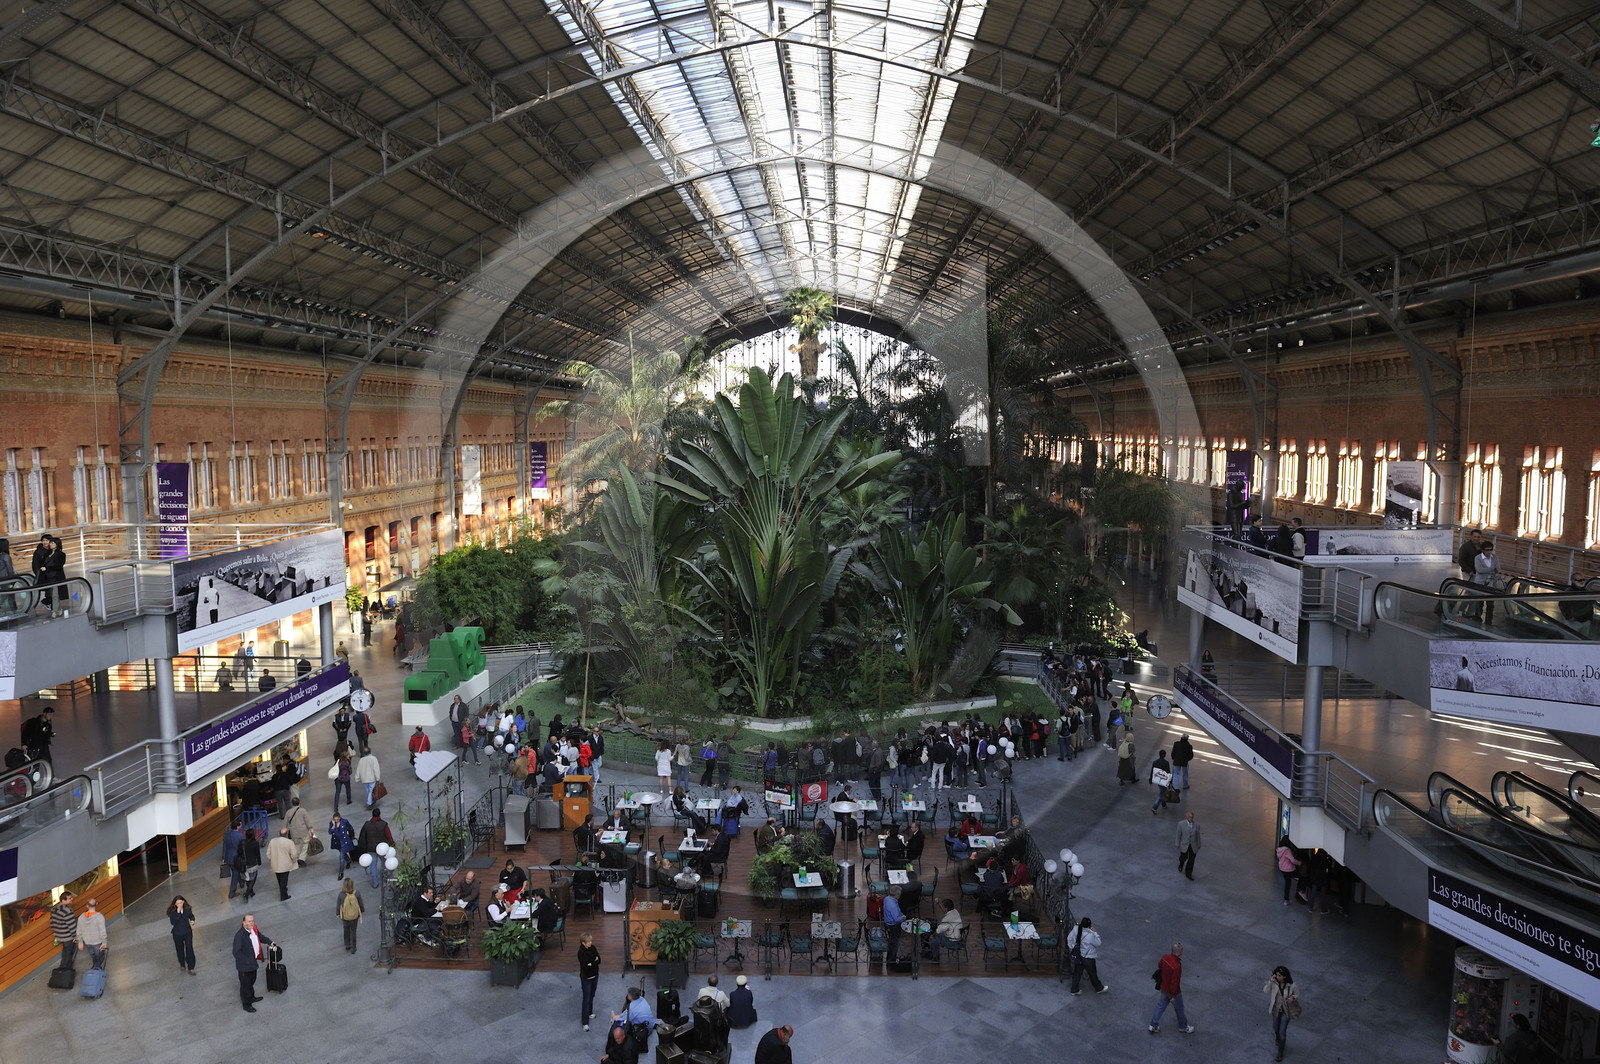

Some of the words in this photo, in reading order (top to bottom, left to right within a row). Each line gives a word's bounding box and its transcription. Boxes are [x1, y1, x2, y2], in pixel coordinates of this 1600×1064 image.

[159, 489, 183, 498] grandes
[167, 512, 187, 522] siguen
[1474, 655, 1522, 672] Necesitamos
[1524, 657, 1578, 677] financiación.
[191, 742, 204, 755] Las
[204, 728, 229, 751] grandes
[230, 714, 260, 734] decisiones
[260, 710, 266, 718] te
[267, 701, 284, 716] siguen
[289, 688, 304, 704] donde
[305, 683, 318, 695] vayas
[1432, 876, 1450, 898] Las
[1452, 894, 1492, 918] grandes
[1494, 903, 1555, 947] decisiones
[1558, 936, 1571, 954] te
